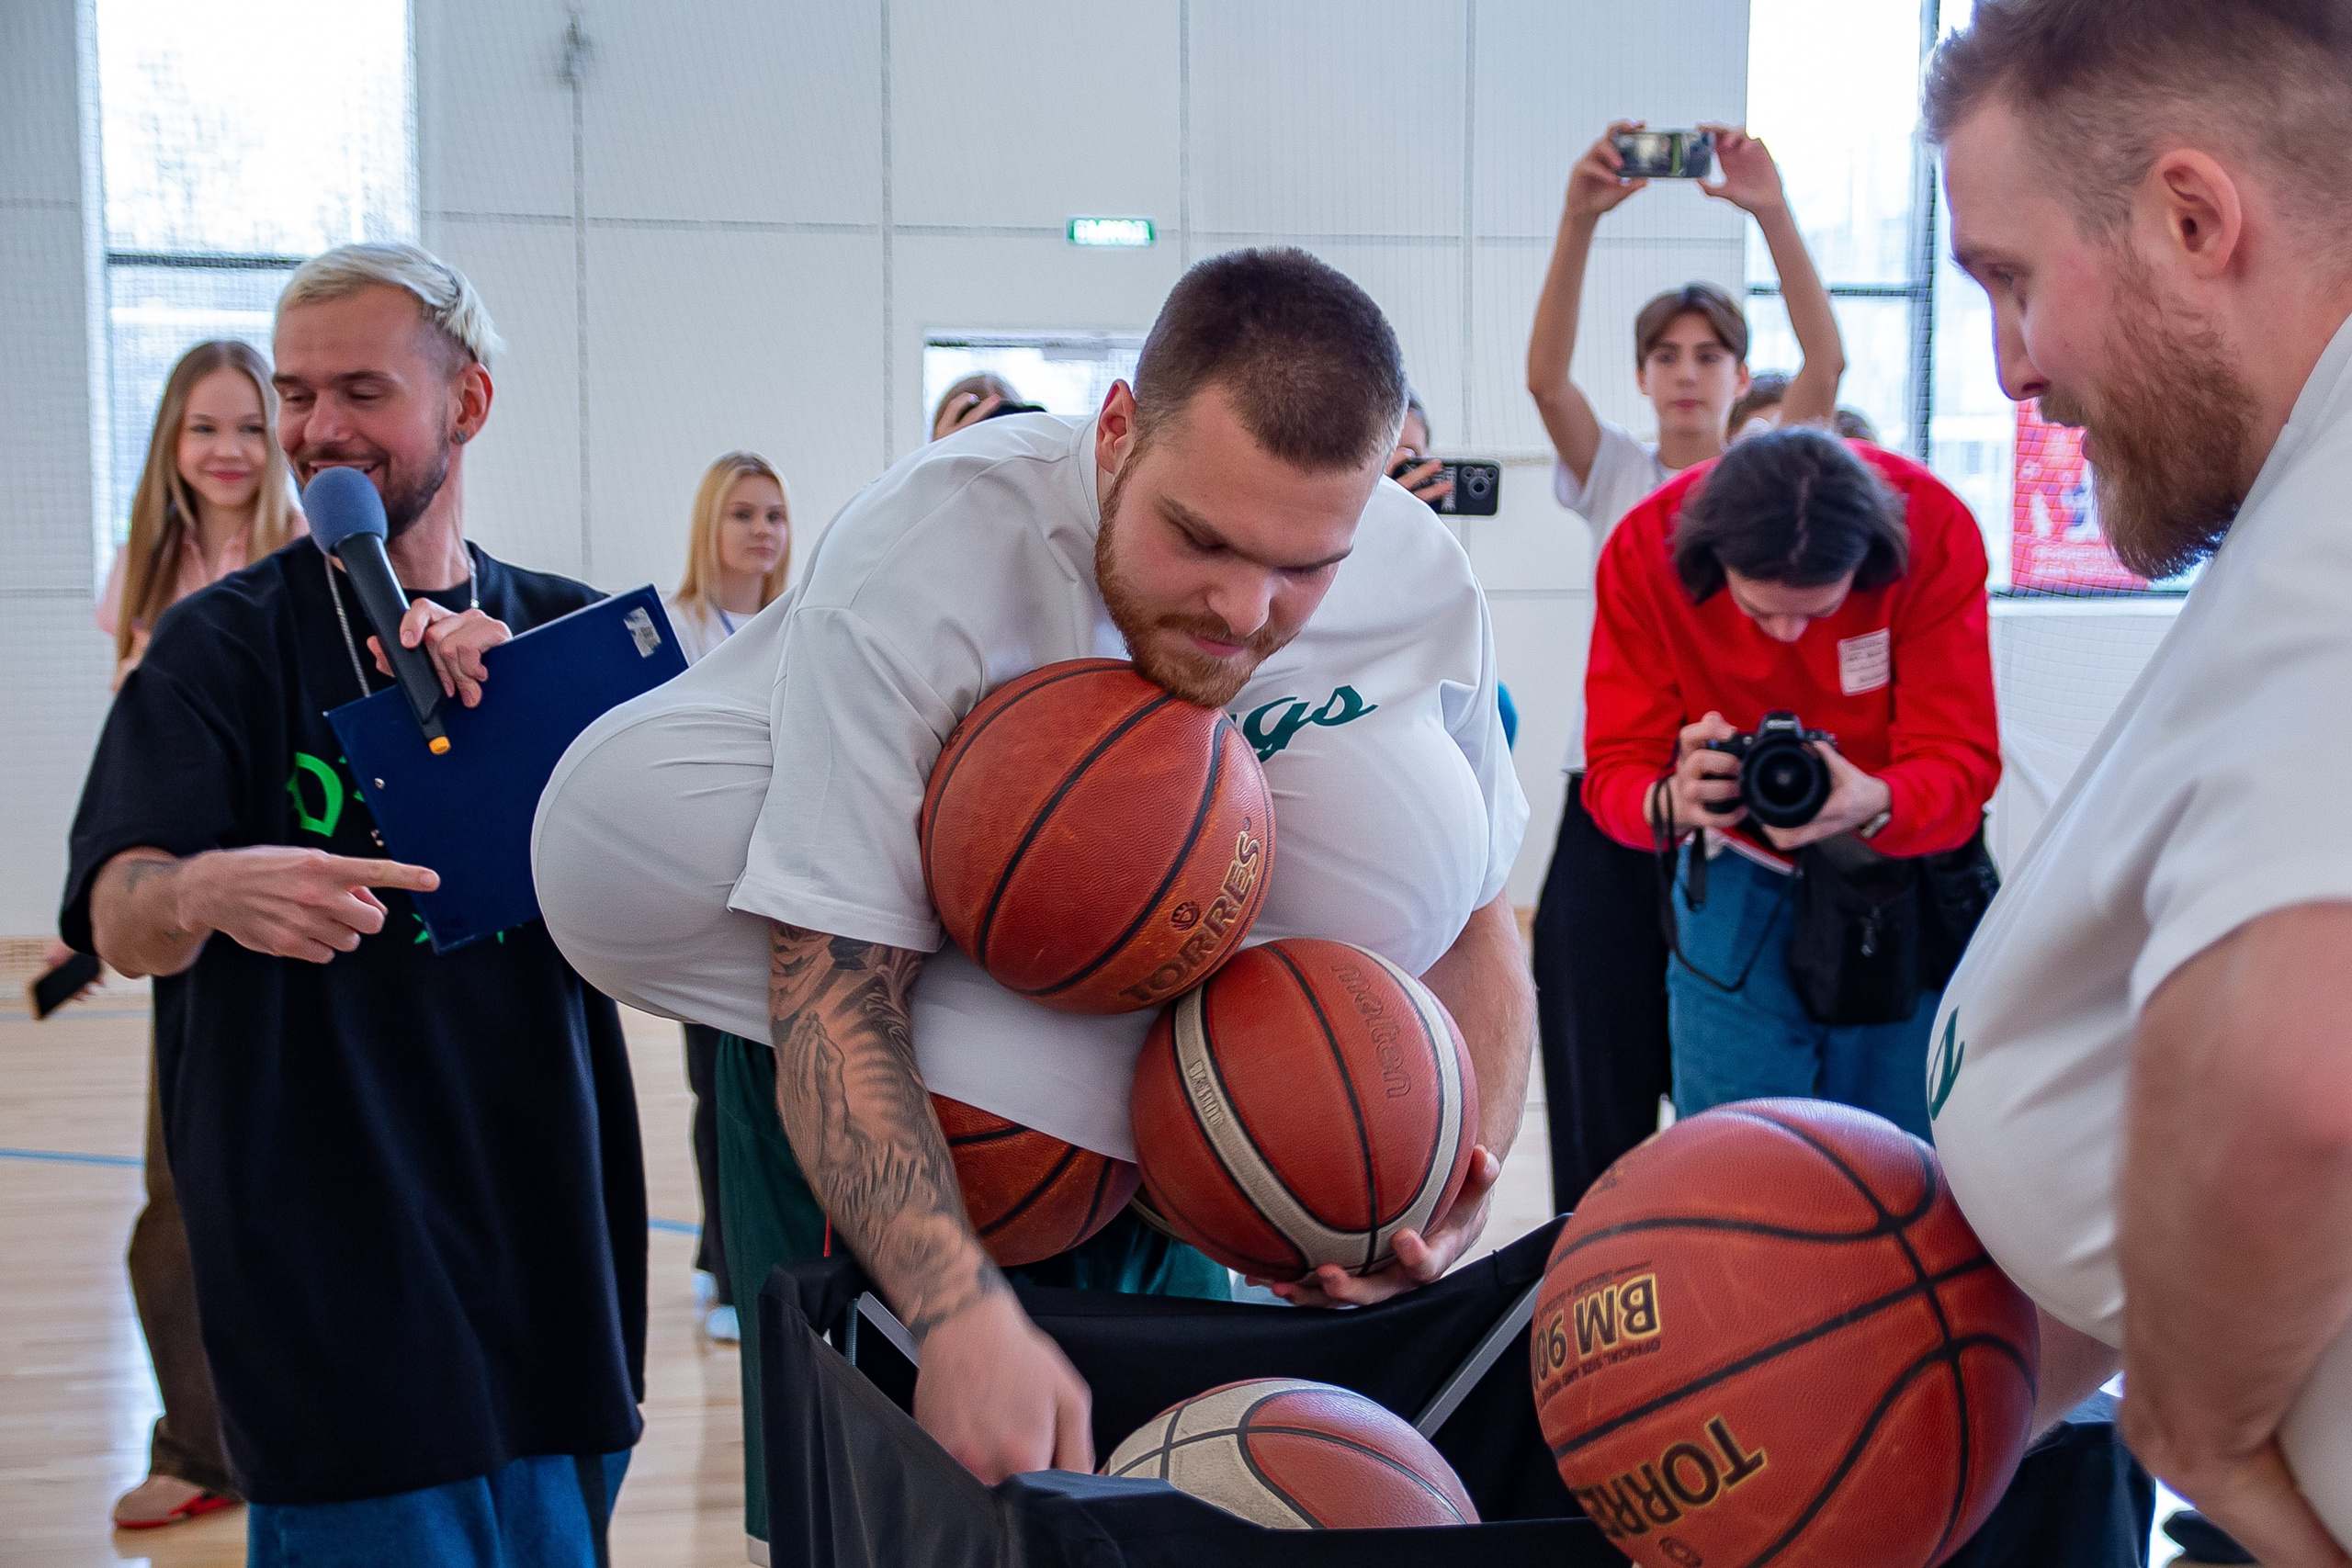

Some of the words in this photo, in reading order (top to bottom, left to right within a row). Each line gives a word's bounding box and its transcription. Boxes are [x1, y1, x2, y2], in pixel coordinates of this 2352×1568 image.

[1230, 685, 1379, 763] gs
[1118, 830, 1261, 1003] TORRES
[1329, 964, 1412, 1100] molten
[1574, 1273, 1661, 1359] BM
